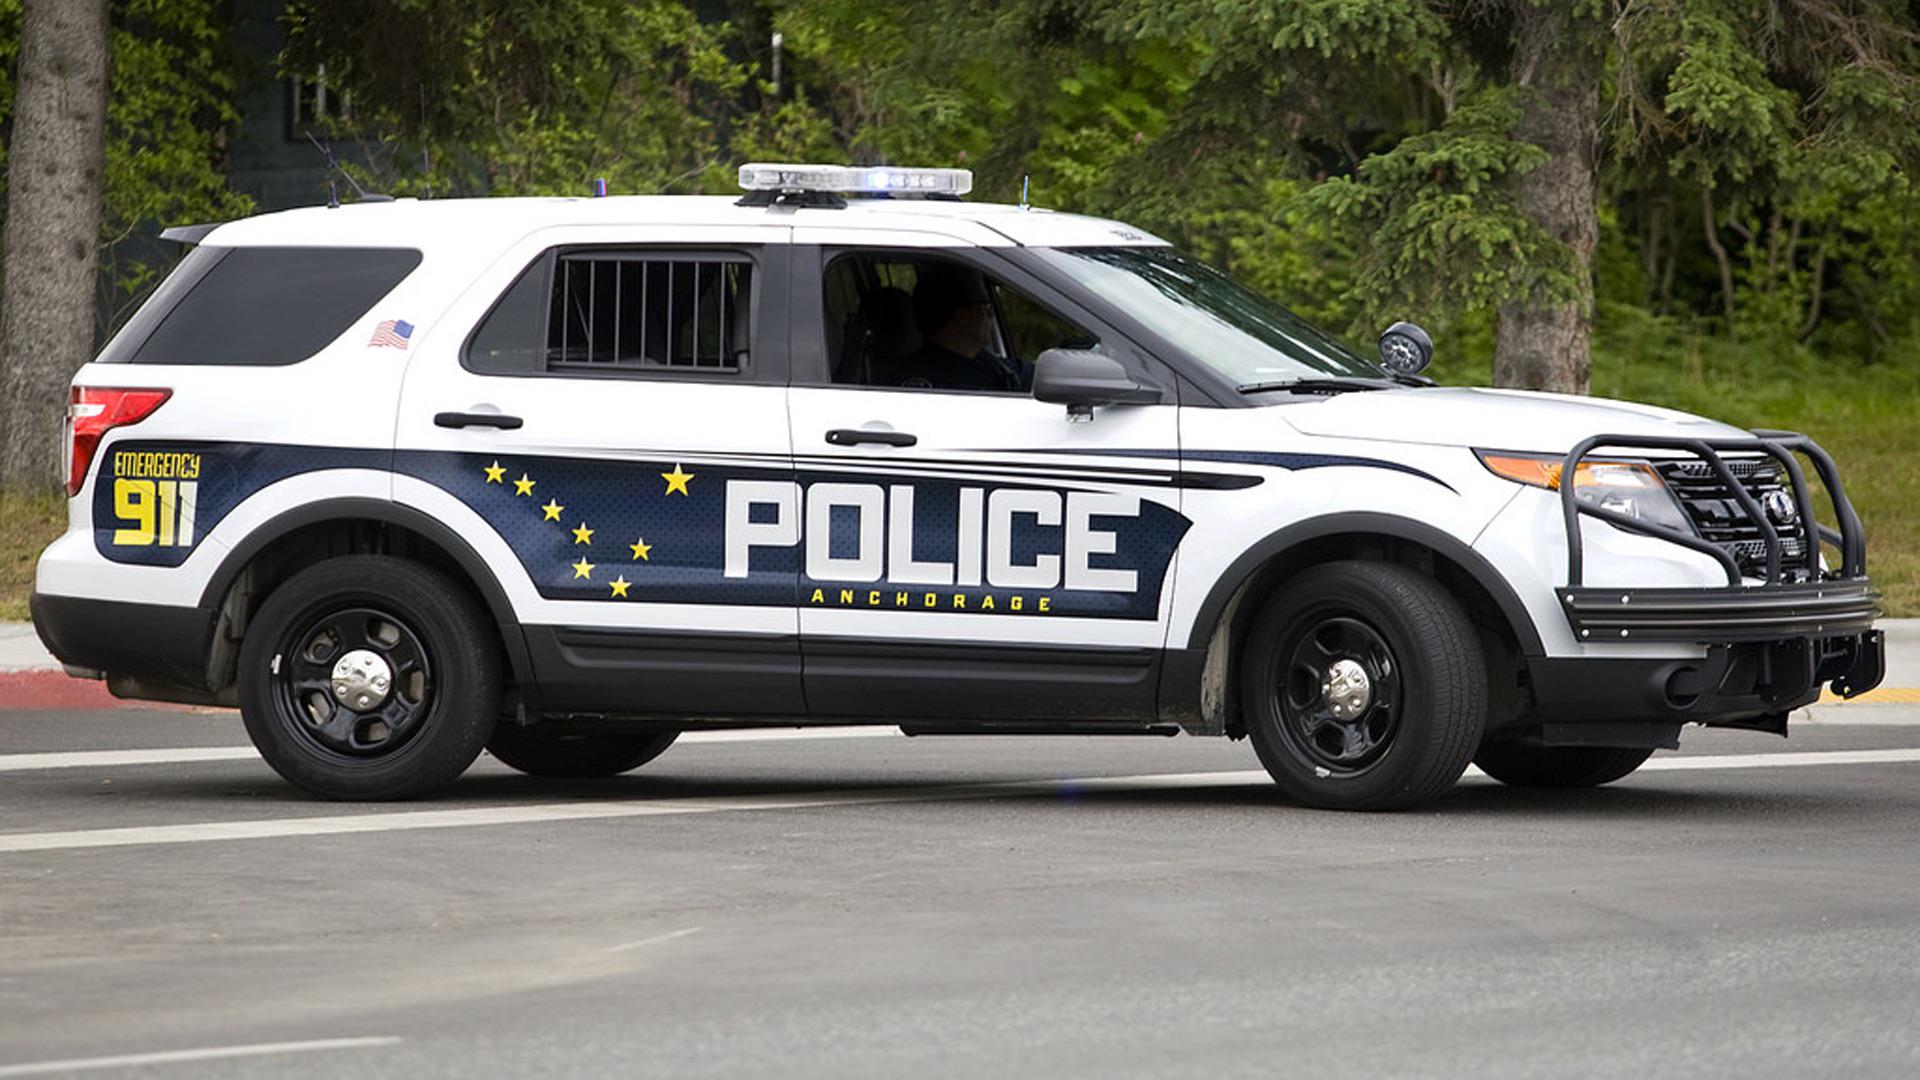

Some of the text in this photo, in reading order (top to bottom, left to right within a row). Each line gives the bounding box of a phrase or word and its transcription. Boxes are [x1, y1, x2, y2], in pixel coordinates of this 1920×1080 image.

[114, 451, 201, 479] EMERGENCY
[113, 477, 198, 547] 911
[723, 479, 1141, 593] POLICE
[811, 588, 1051, 612] ANCHORAGE
